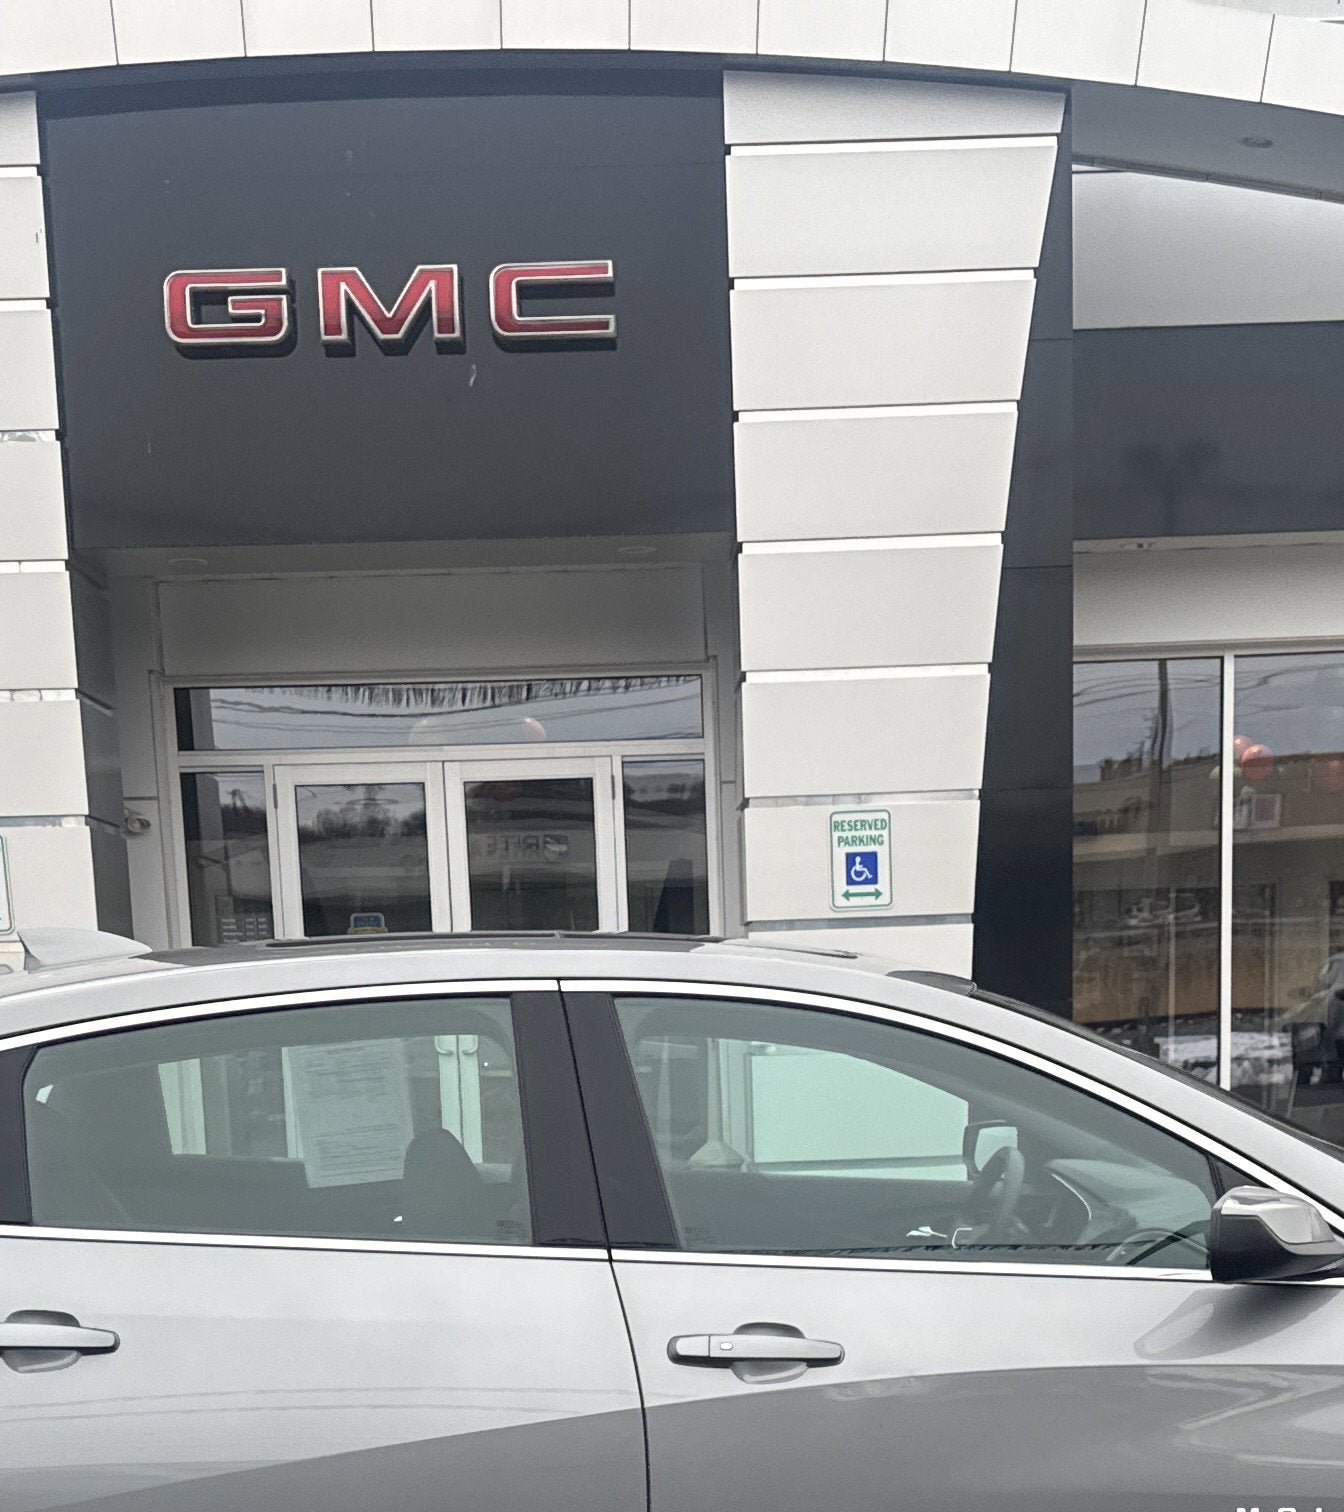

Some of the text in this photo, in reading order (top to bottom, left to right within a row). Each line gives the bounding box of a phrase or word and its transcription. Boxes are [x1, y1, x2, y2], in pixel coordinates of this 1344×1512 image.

[162, 259, 617, 352] GMC
[833, 818, 887, 832] RESERVED
[837, 834, 884, 848] PARKING
